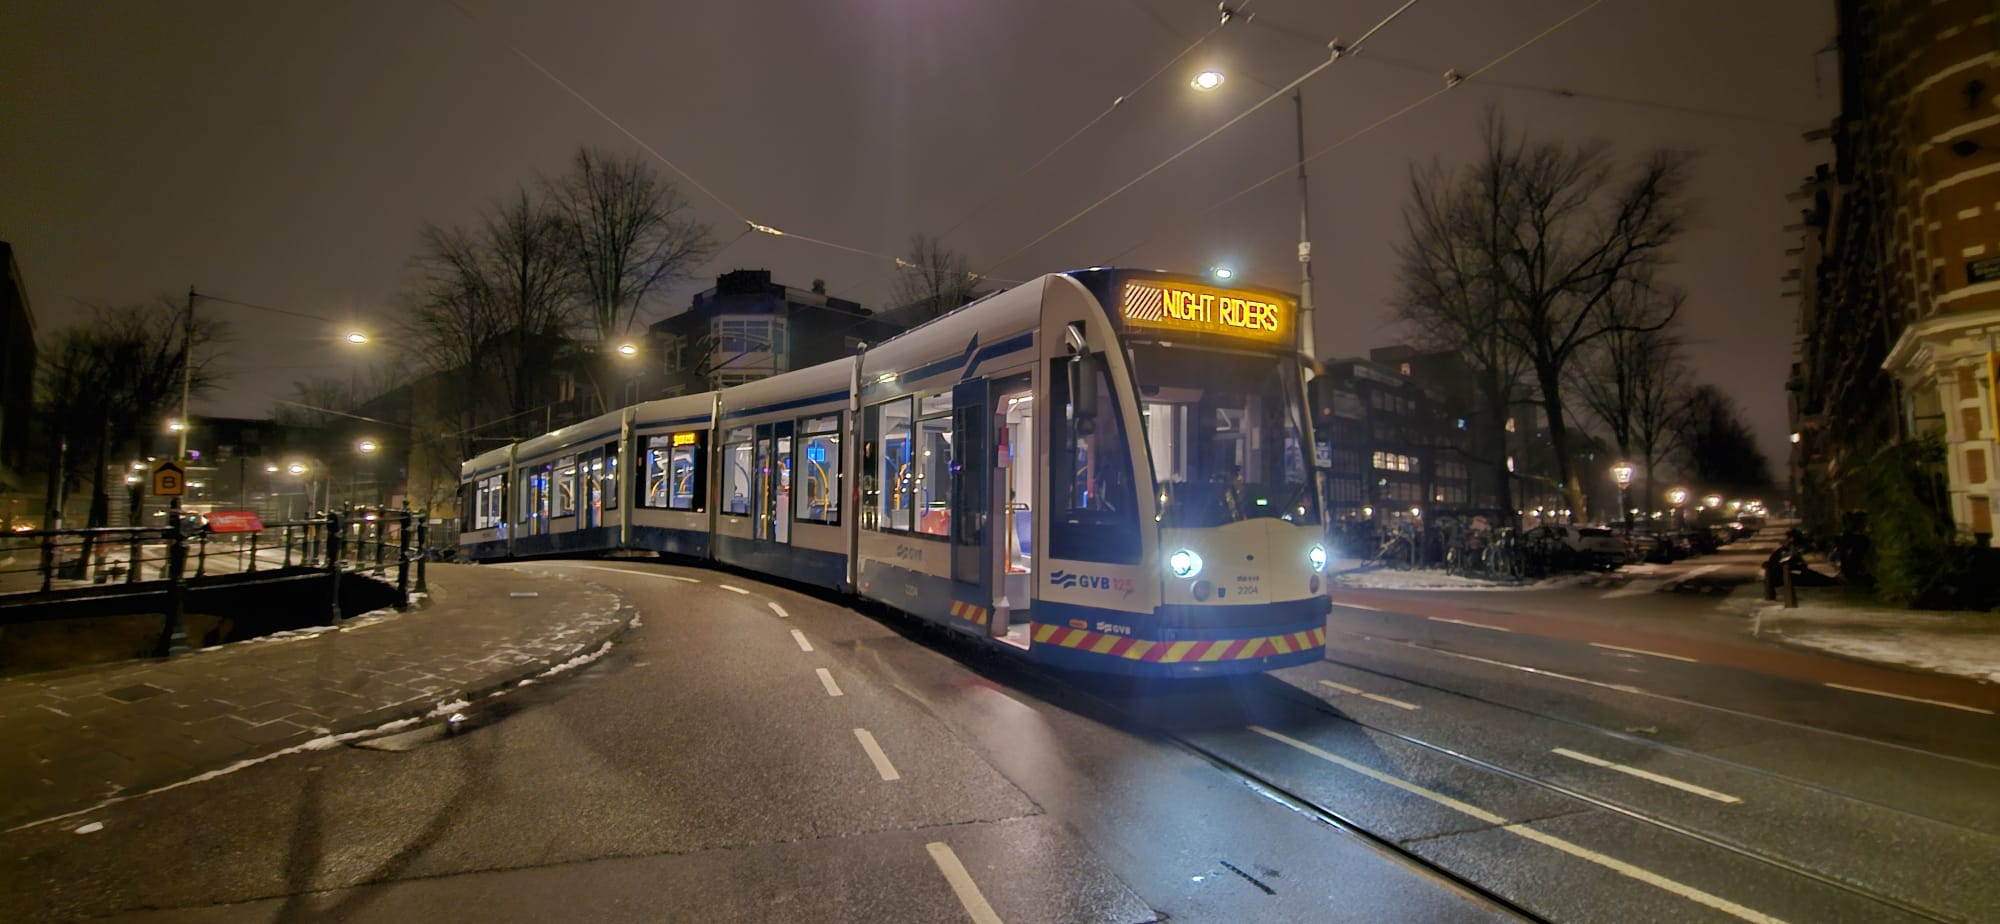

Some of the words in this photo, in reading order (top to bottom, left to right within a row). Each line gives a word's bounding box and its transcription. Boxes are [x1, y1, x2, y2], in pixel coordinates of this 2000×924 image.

[1163, 289, 1214, 322] NIGHT
[1220, 297, 1277, 331] RIDERS
[1079, 575, 1110, 590] GVB
[1112, 624, 1131, 635] GVB
